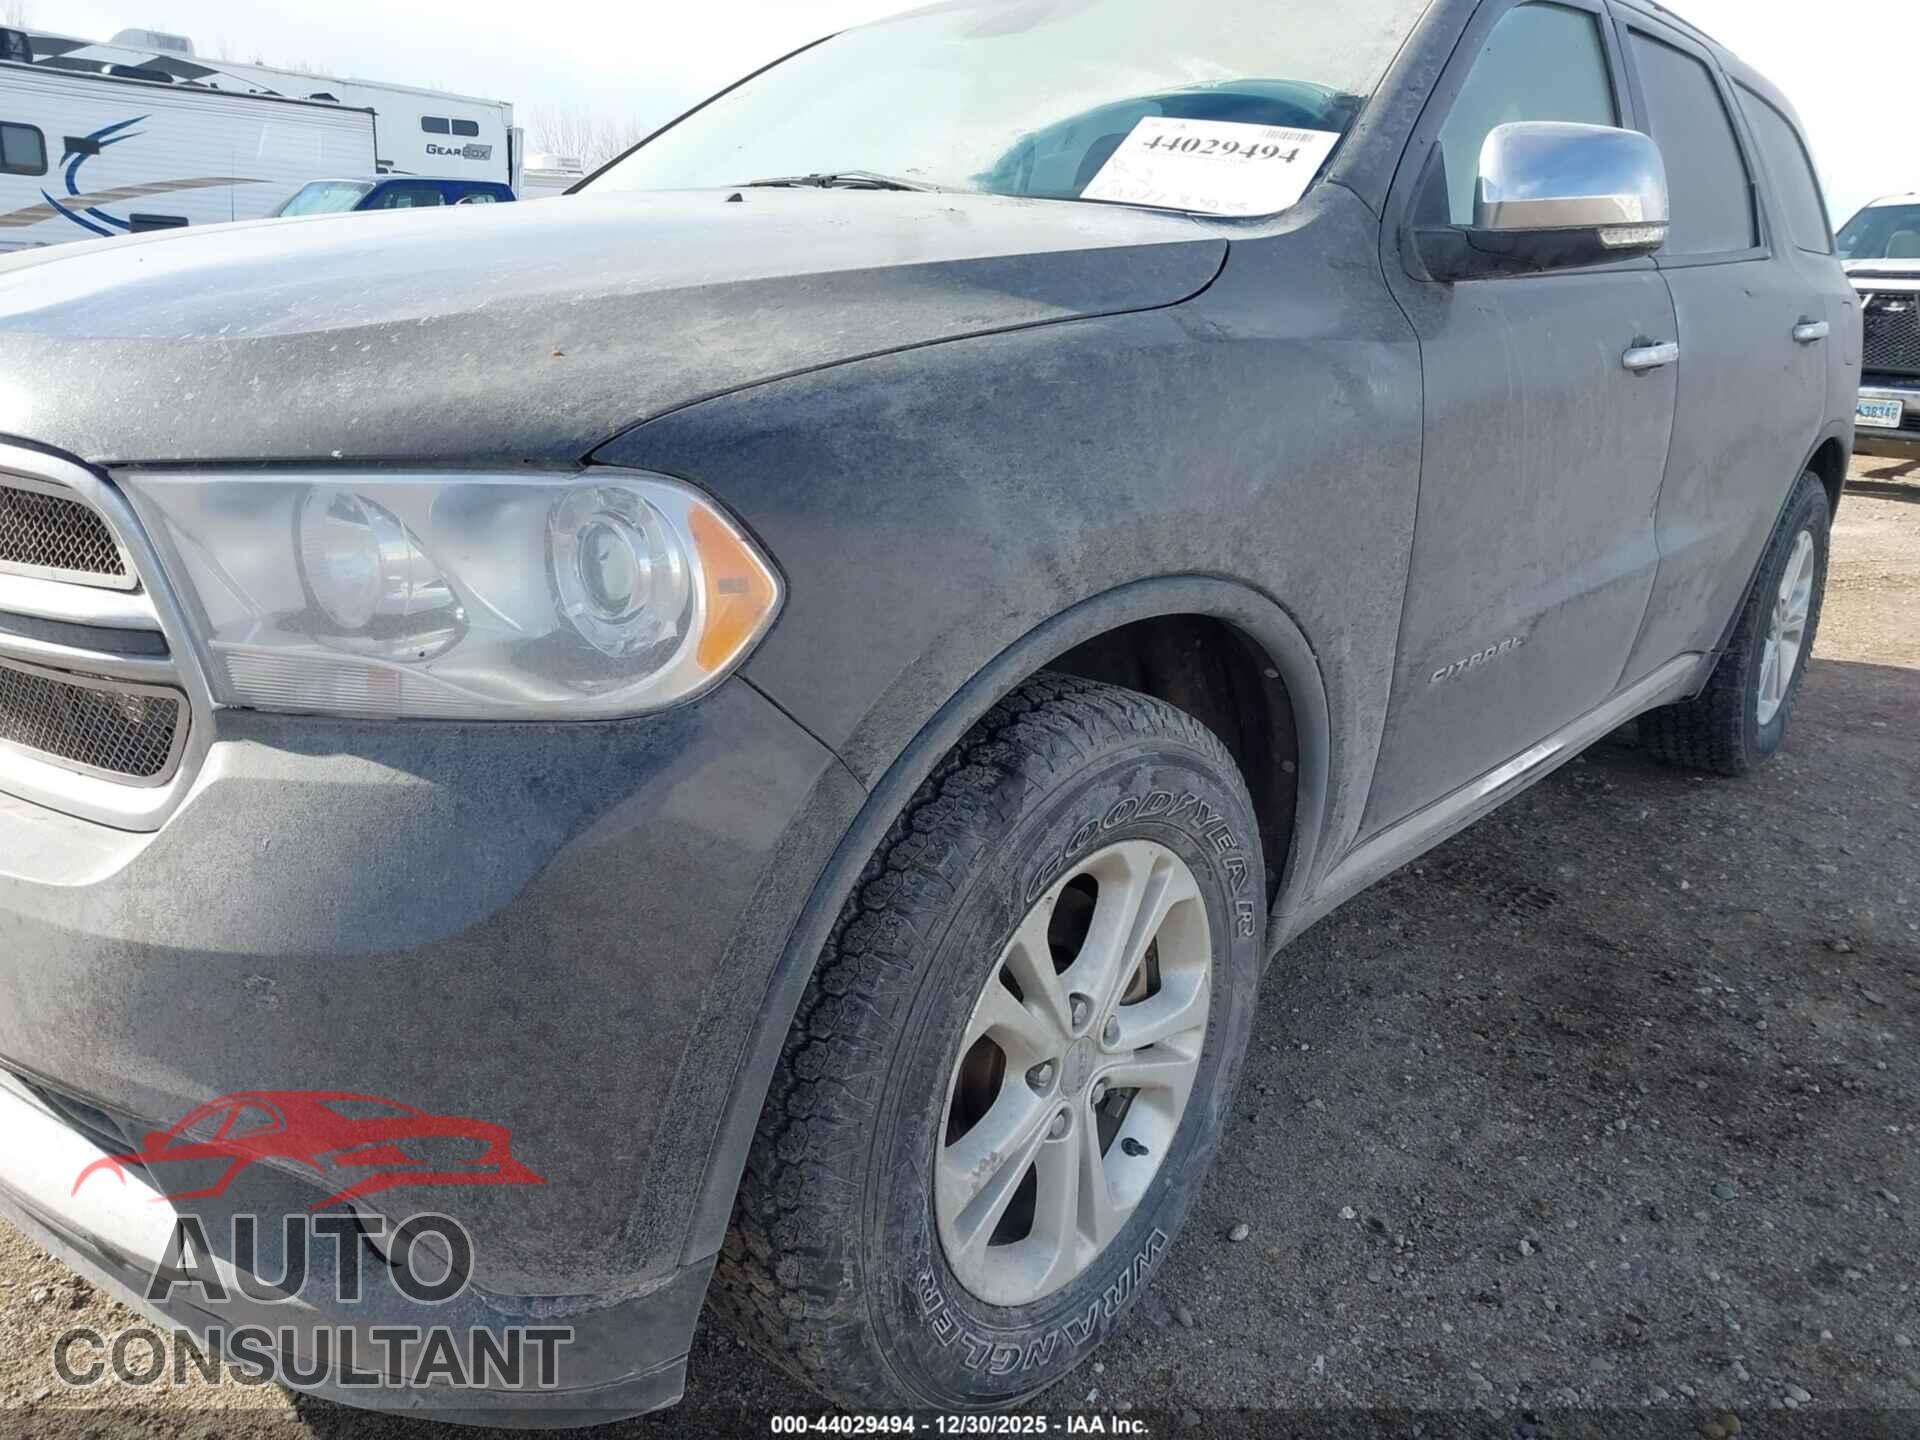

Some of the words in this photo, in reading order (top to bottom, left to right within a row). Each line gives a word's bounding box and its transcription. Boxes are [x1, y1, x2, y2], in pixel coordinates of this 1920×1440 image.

[1142, 134, 1301, 165] 44029494
[1025, 790, 1256, 938] GOODYEAR
[916, 1227, 1169, 1376] WRANGLER
